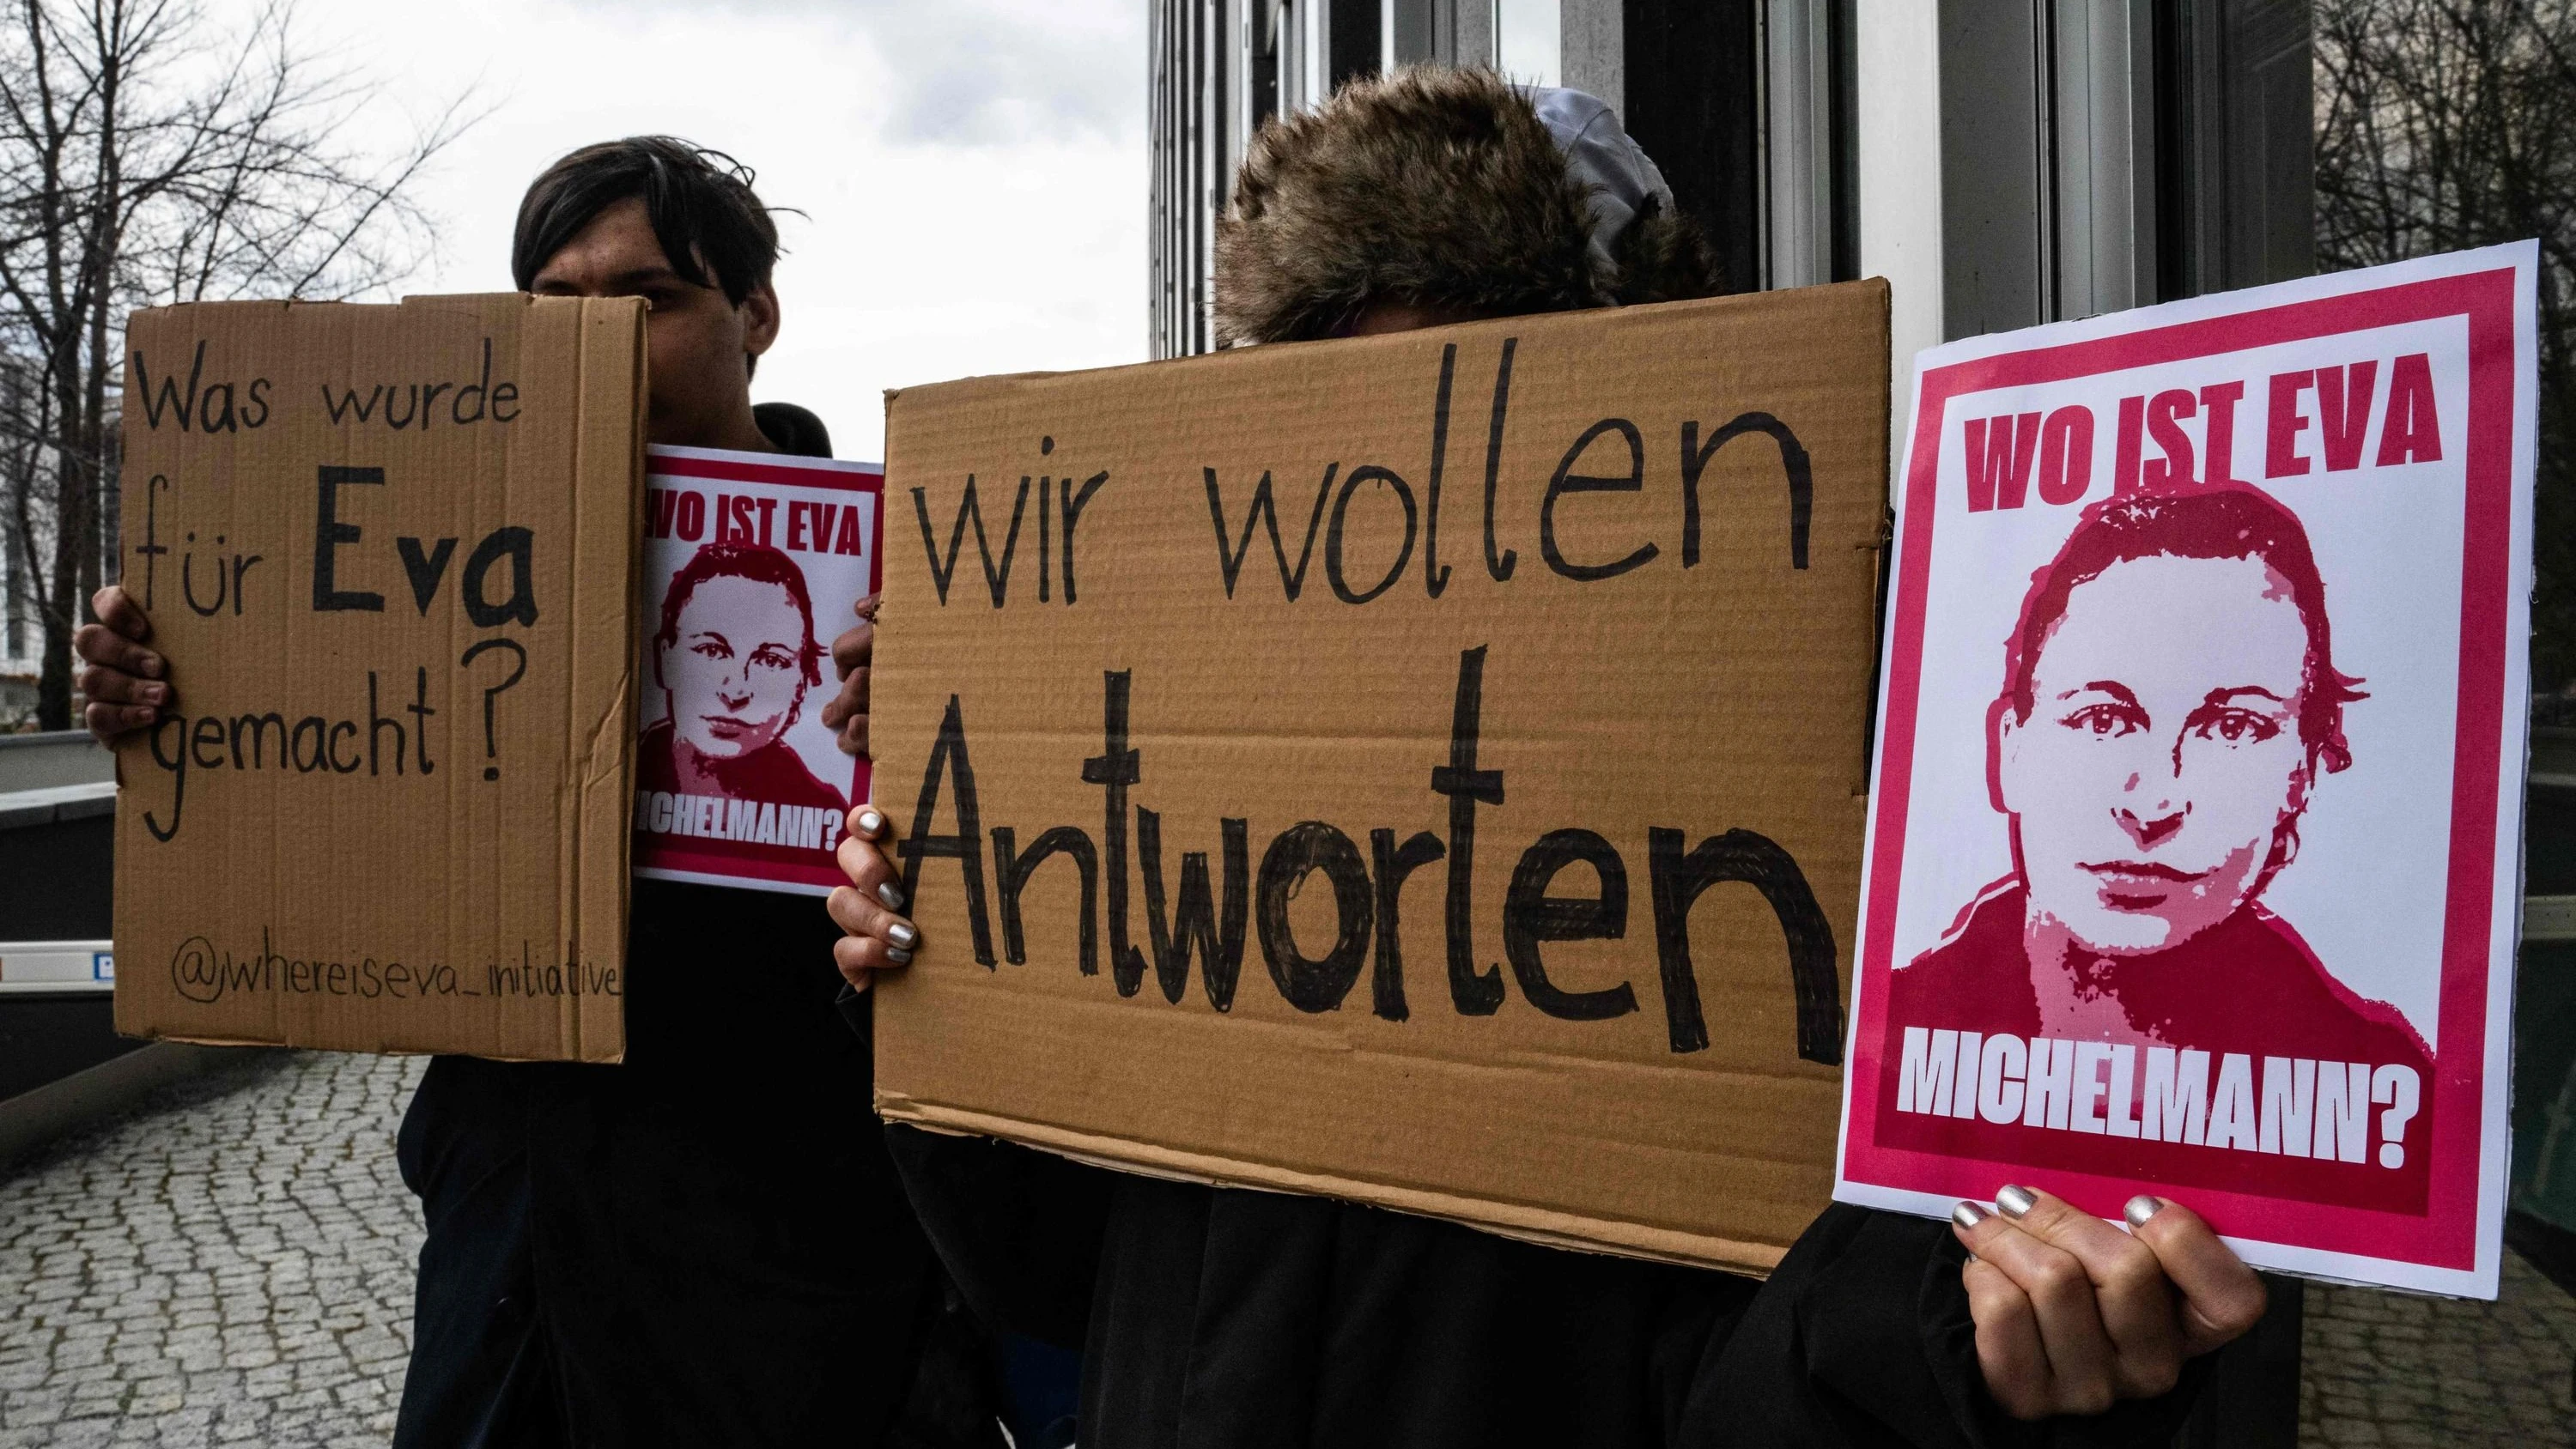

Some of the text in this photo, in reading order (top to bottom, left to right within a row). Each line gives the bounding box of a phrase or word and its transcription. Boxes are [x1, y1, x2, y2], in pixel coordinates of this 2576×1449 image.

[132, 337, 522, 433] Was wurde
[1964, 352, 2443, 513] WO IST EVA
[645, 488, 863, 556] WO IST EVA
[909, 336, 1814, 609] wir wollen
[135, 464, 539, 628] für Eva
[636, 790, 844, 852] ICHELMANN?
[896, 643, 1846, 1066] Antworten
[173, 925, 623, 1003] @whereiseva_initiative
[1896, 1026, 2421, 1170] MICHELMANN?
